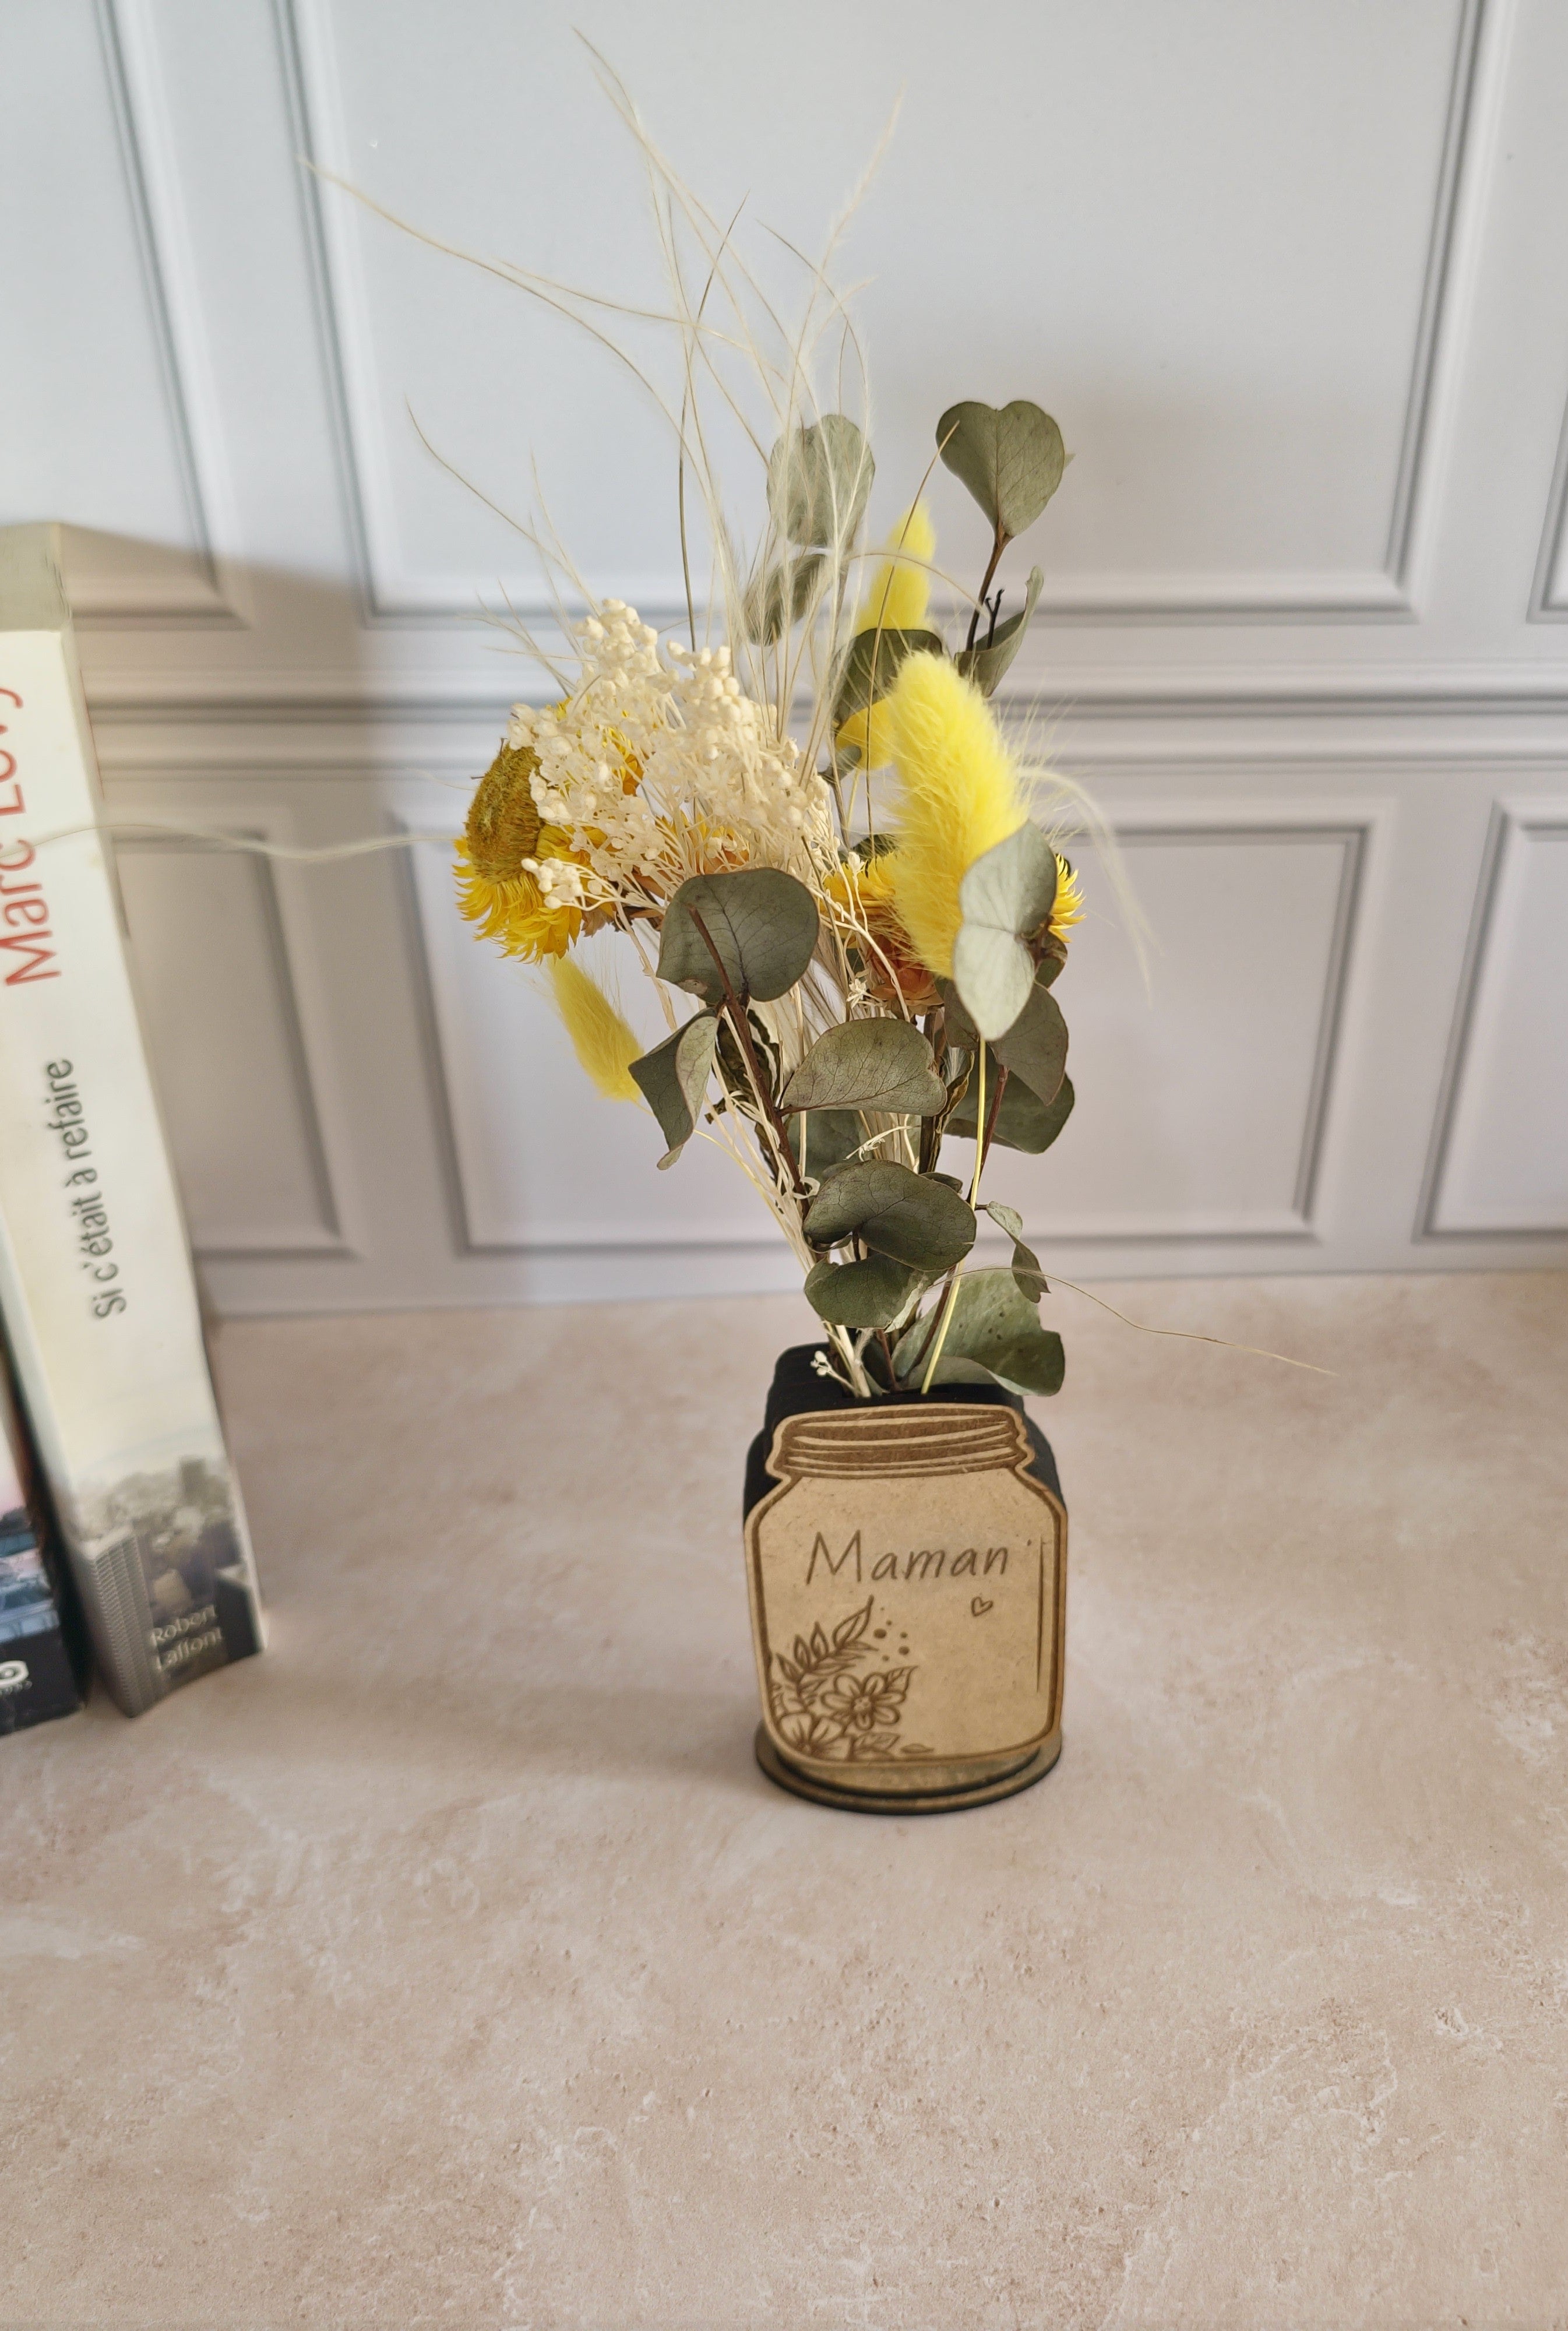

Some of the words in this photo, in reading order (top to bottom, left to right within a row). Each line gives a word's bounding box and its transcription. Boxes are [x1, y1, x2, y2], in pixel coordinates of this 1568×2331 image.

[0, 837, 62, 987] Marc
[45, 1058, 92, 1160] refaire
[65, 1167, 98, 1189] à
[71, 1189, 119, 1283] c'était
[93, 1288, 127, 1320] Si
[806, 1529, 1009, 1586] Maman
